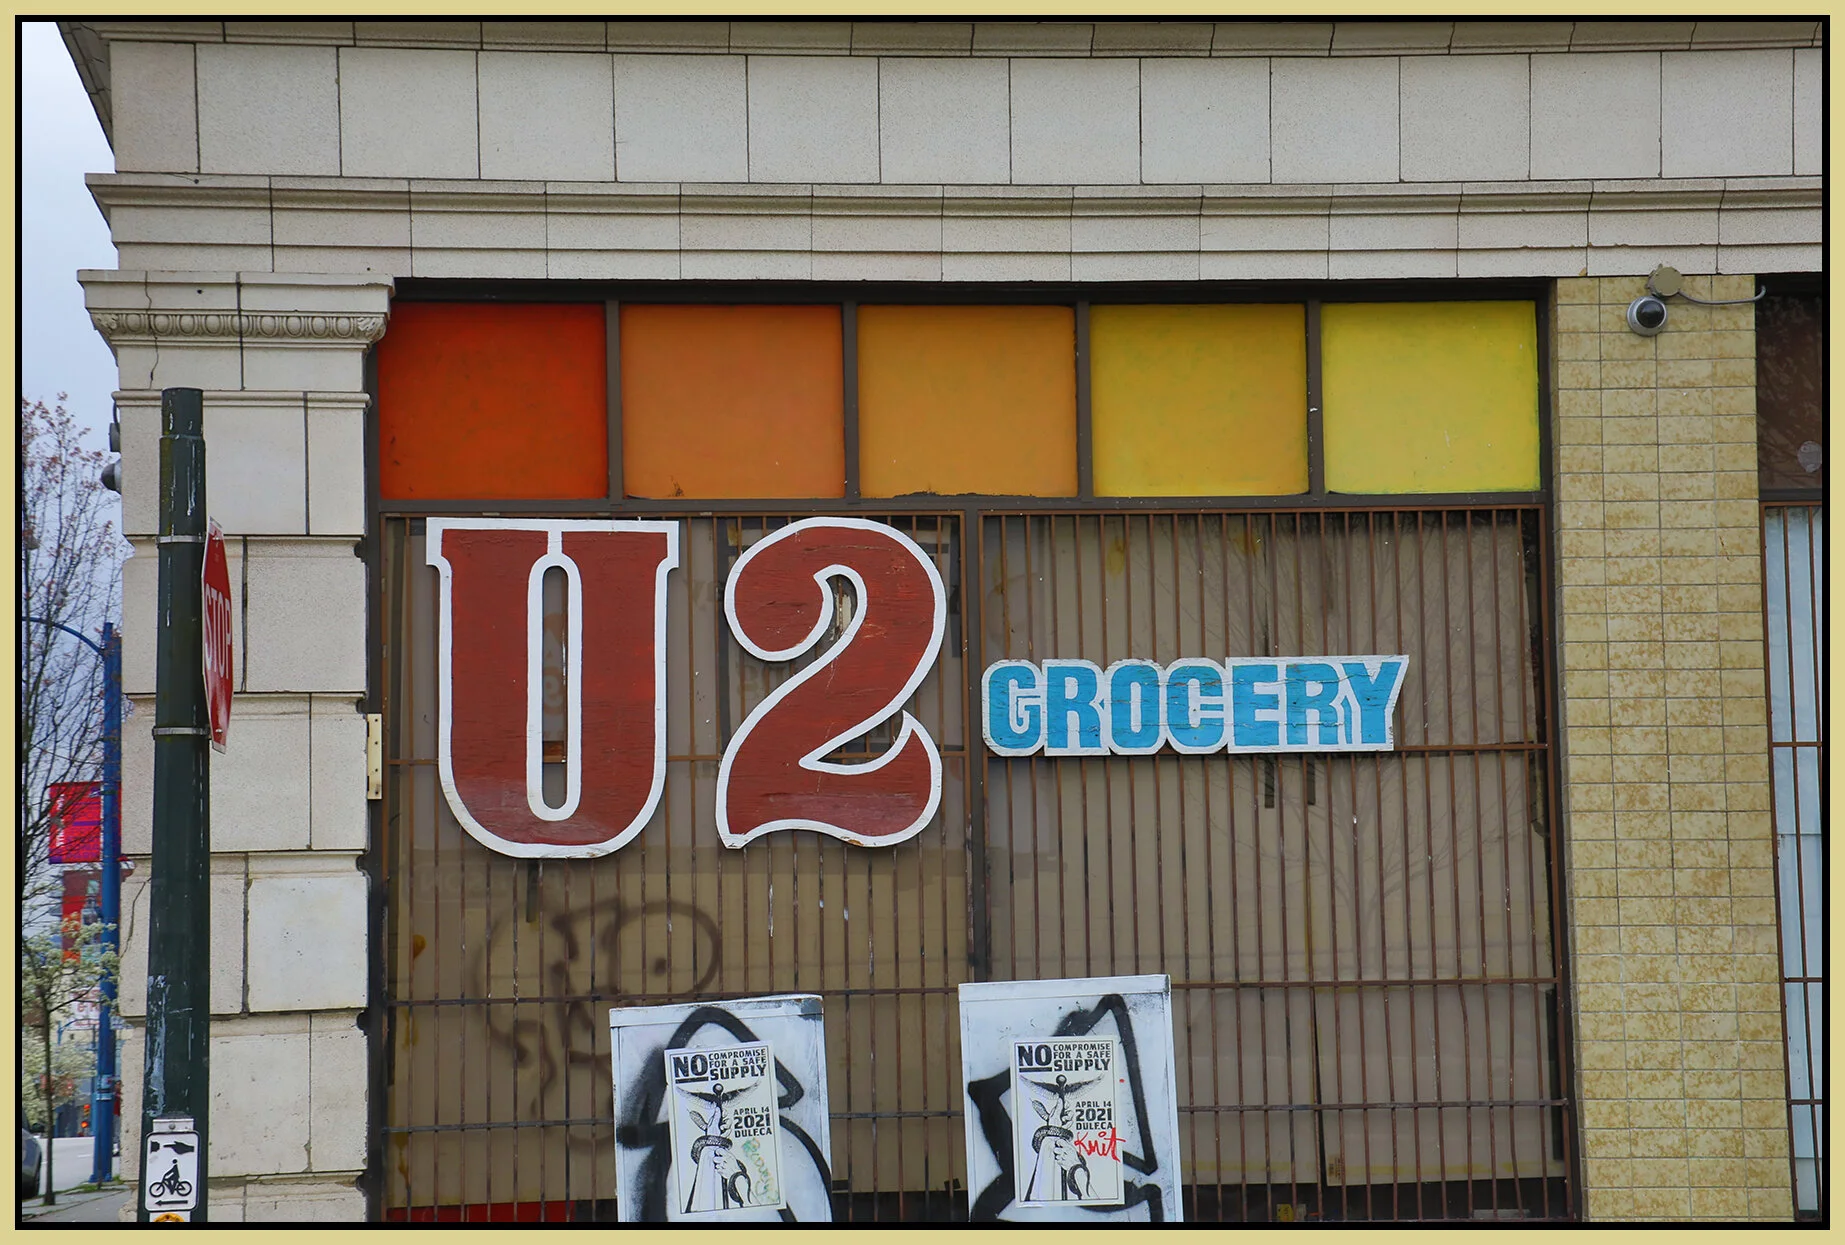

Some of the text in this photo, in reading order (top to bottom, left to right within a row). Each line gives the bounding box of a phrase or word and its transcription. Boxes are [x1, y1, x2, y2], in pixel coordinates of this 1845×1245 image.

[204, 582, 232, 680] STOP
[426, 517, 1408, 858] U2 GROCERY
[709, 1048, 766, 1060] COMPROMISE
[1053, 1042, 1111, 1052] COMPROMISE
[1017, 1044, 1052, 1067] NO
[1053, 1049, 1111, 1060] FOR A SAFE
[673, 1054, 708, 1077] NO
[709, 1056, 767, 1069] FOR A SAFE
[1053, 1058, 1111, 1072] SUPPLY
[710, 1064, 767, 1081] SUPPLY
[1075, 1100, 1100, 1108] APRIL
[733, 1107, 758, 1116] APRIL
[1075, 1107, 1112, 1122] 2021
[734, 1113, 771, 1130] 2021
